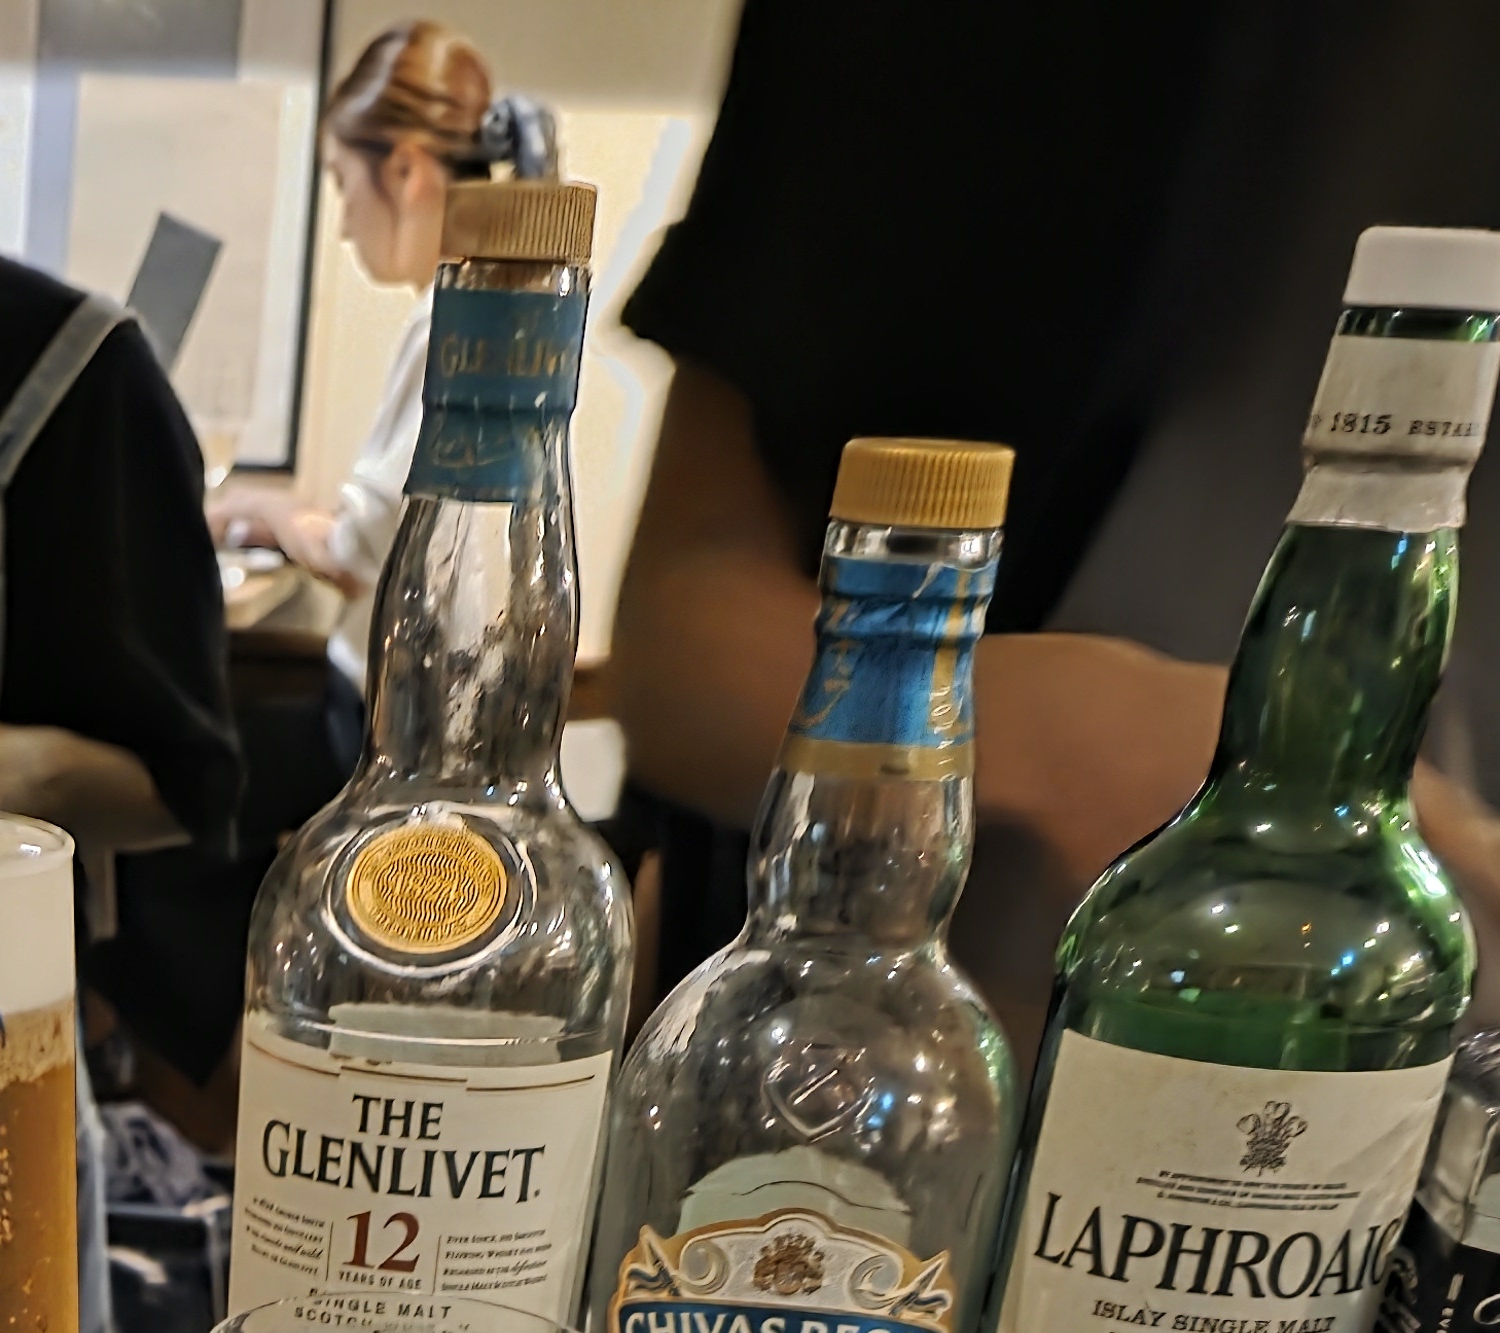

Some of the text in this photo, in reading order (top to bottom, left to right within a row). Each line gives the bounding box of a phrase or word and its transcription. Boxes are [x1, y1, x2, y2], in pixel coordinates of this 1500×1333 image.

[352, 1094, 444, 1141] THE
[342, 1209, 422, 1274] 12
[397, 1303, 452, 1319] MALT
[1091, 1299, 1167, 1328] ISLAY
